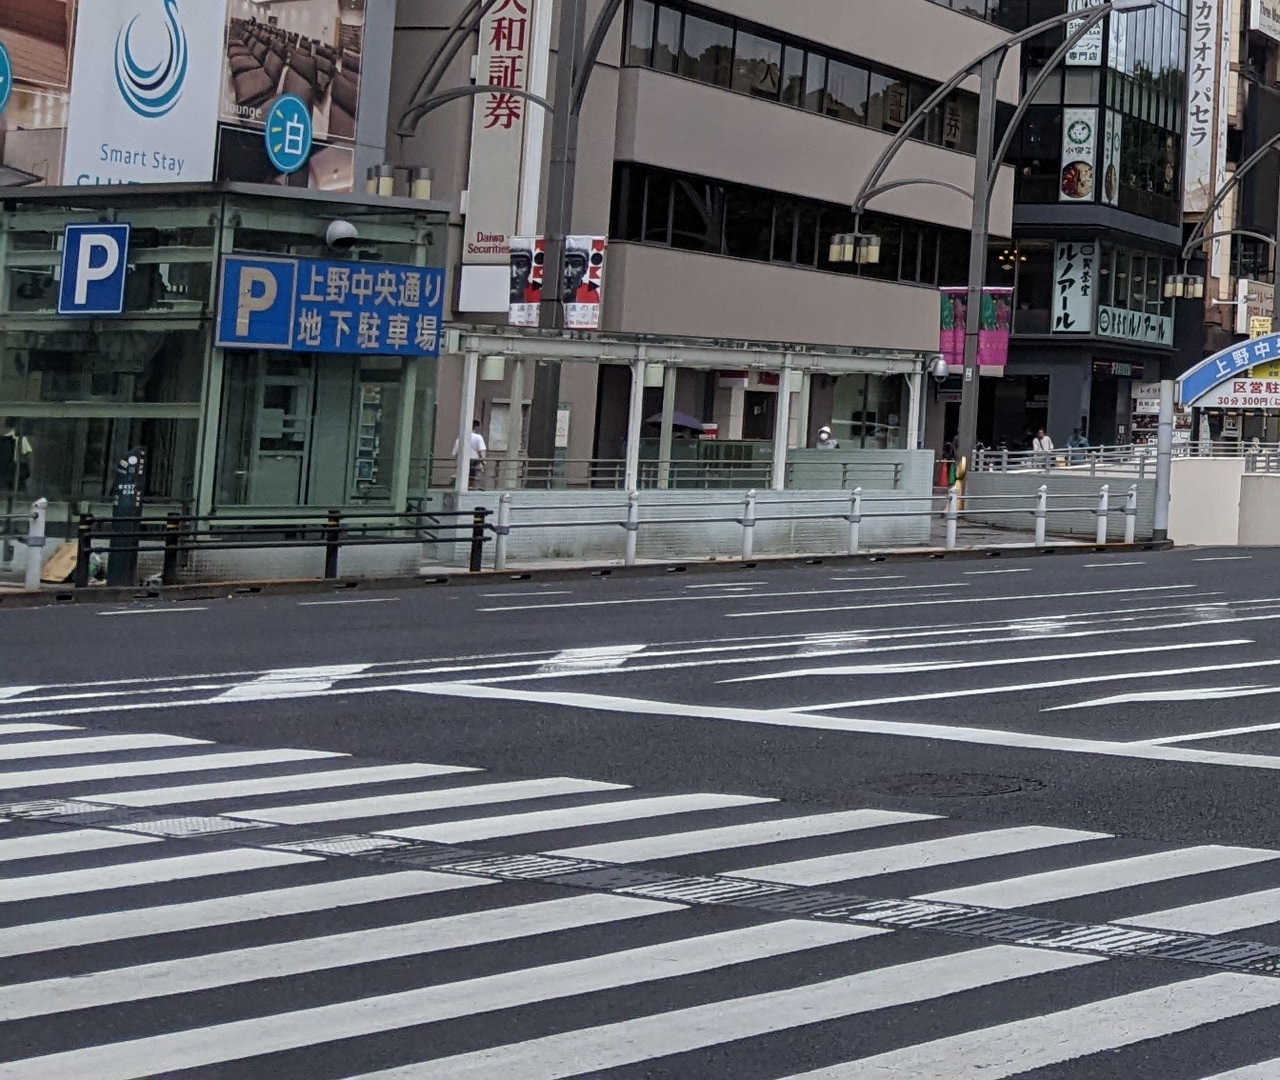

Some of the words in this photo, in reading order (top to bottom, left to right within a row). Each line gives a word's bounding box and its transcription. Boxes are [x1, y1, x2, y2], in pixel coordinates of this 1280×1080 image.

[1191, 0, 1213, 84] カラオケ
[225, 102, 263, 120] lounge
[1189, 86, 1212, 147] パセラ
[100, 143, 147, 168] Smart
[153, 151, 185, 177] Stay
[467, 243, 511, 254] Securities
[476, 232, 505, 243] Daiwa
[74, 233, 119, 305] P
[301, 264, 442, 309] 上野中央通り
[1055, 243, 1078, 330] ルノアール
[235, 266, 278, 337] P
[297, 306, 439, 352] 地下駐車場
